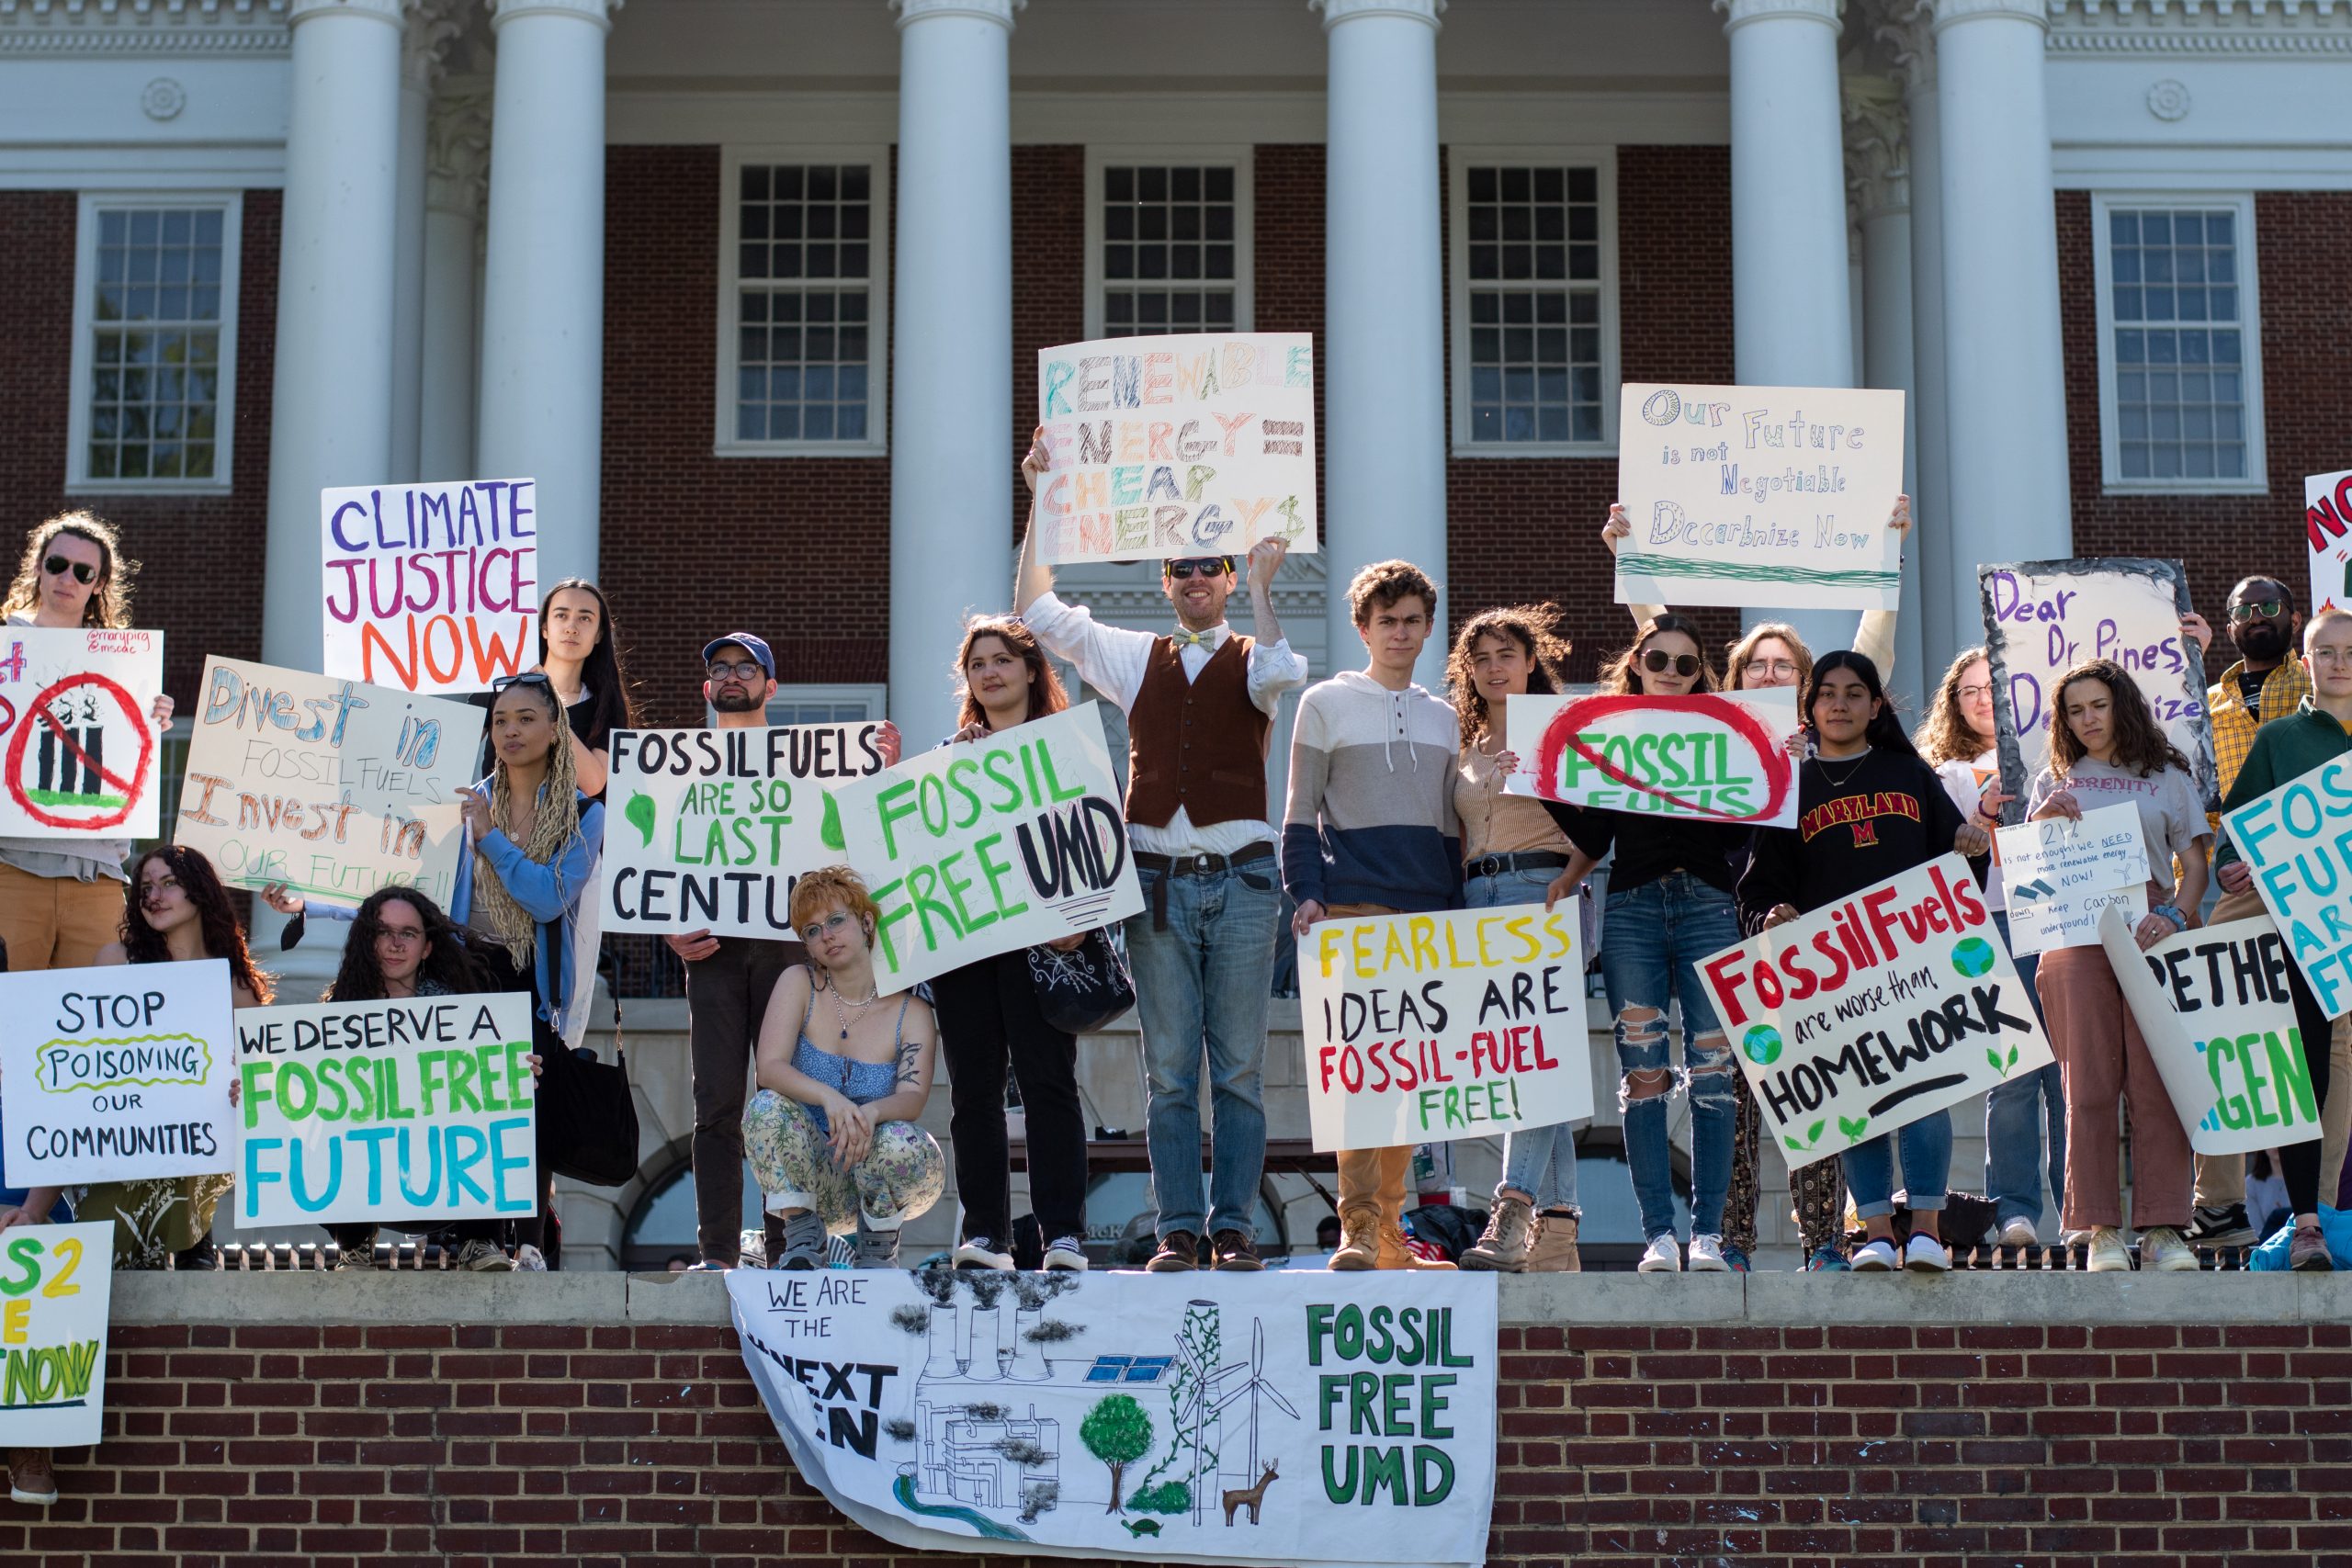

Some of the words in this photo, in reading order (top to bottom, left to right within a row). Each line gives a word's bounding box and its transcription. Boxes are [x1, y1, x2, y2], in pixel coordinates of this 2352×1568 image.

[1045, 342, 1312, 420] RENEWABLE
[1042, 412, 1258, 470] ENERGY
[1642, 389, 1731, 427] Our
[1742, 409, 1865, 451] Future
[1662, 446, 1680, 465] is
[1690, 441, 1729, 462] not
[1043, 464, 1217, 517] CHEAP
[1720, 463, 1847, 503] Negotiable
[331, 481, 537, 552] CLIMATE
[1043, 498, 1278, 558] ENERGY
[1814, 513, 1870, 549] Now
[325, 546, 538, 624] JUSTICE
[1993, 572, 2077, 623] Dear
[361, 613, 528, 692] NOW
[2048, 624, 2080, 668] Dr
[203, 665, 370, 749] Divest
[395, 703, 442, 770] in
[242, 739, 356, 786] FOSSIL
[356, 757, 442, 805] FUELS
[611, 730, 760, 778] FOSSIL
[766, 725, 883, 779] FUELS
[1565, 732, 1754, 789] FOSSIL
[179, 772, 363, 844] Invest
[379, 803, 428, 861] in
[680, 782, 736, 816] ARE
[749, 779, 792, 815] SO
[876, 738, 1087, 861] FOSSIL
[1800, 792, 1922, 843] MARYLAND
[219, 839, 293, 880] OUR
[674, 815, 794, 866] LAST
[1849, 819, 1881, 848] M
[2017, 853, 2031, 863] not
[2101, 832, 2132, 847] NEED
[2060, 854, 2099, 868] renewable
[2102, 849, 2126, 861] energy
[612, 866, 798, 930] CENTU
[868, 831, 1030, 974] FREE
[1013, 795, 1125, 900] UMD
[1319, 913, 1572, 979] FEARLESS
[2040, 914, 2096, 935] underground!
[2195, 932, 2290, 1007] THE
[56, 990, 165, 1033] STOP
[239, 1021, 287, 1055] WE
[294, 1005, 459, 1053] DESERVE
[469, 1005, 502, 1041] A
[1324, 979, 1449, 1043] IDEAS
[1478, 965, 1569, 1025] ARE
[1794, 1010, 1832, 1044] are
[1834, 985, 1891, 1022] worse
[1887, 965, 1939, 1003] than
[46, 1043, 199, 1087] POISONING
[1758, 984, 2032, 1126] HOMEWORK
[2207, 1027, 2318, 1131] GEN
[92, 1093, 143, 1112] OUR
[242, 1055, 416, 1130] FOSSIL
[417, 1041, 534, 1117] FREE
[1419, 1076, 1522, 1132] FREE!
[27, 1122, 218, 1160] COMMUNITIES
[243, 1117, 533, 1218] FUTURE
[767, 1280, 808, 1307] WE
[816, 1276, 869, 1306] ARE
[785, 1316, 831, 1338] THE
[1306, 1303, 1475, 1368] FOSSIL
[3, 1338, 101, 1406] NOW
[1318, 1371, 1458, 1439] FREE
[1321, 1443, 1456, 1507] UMD
